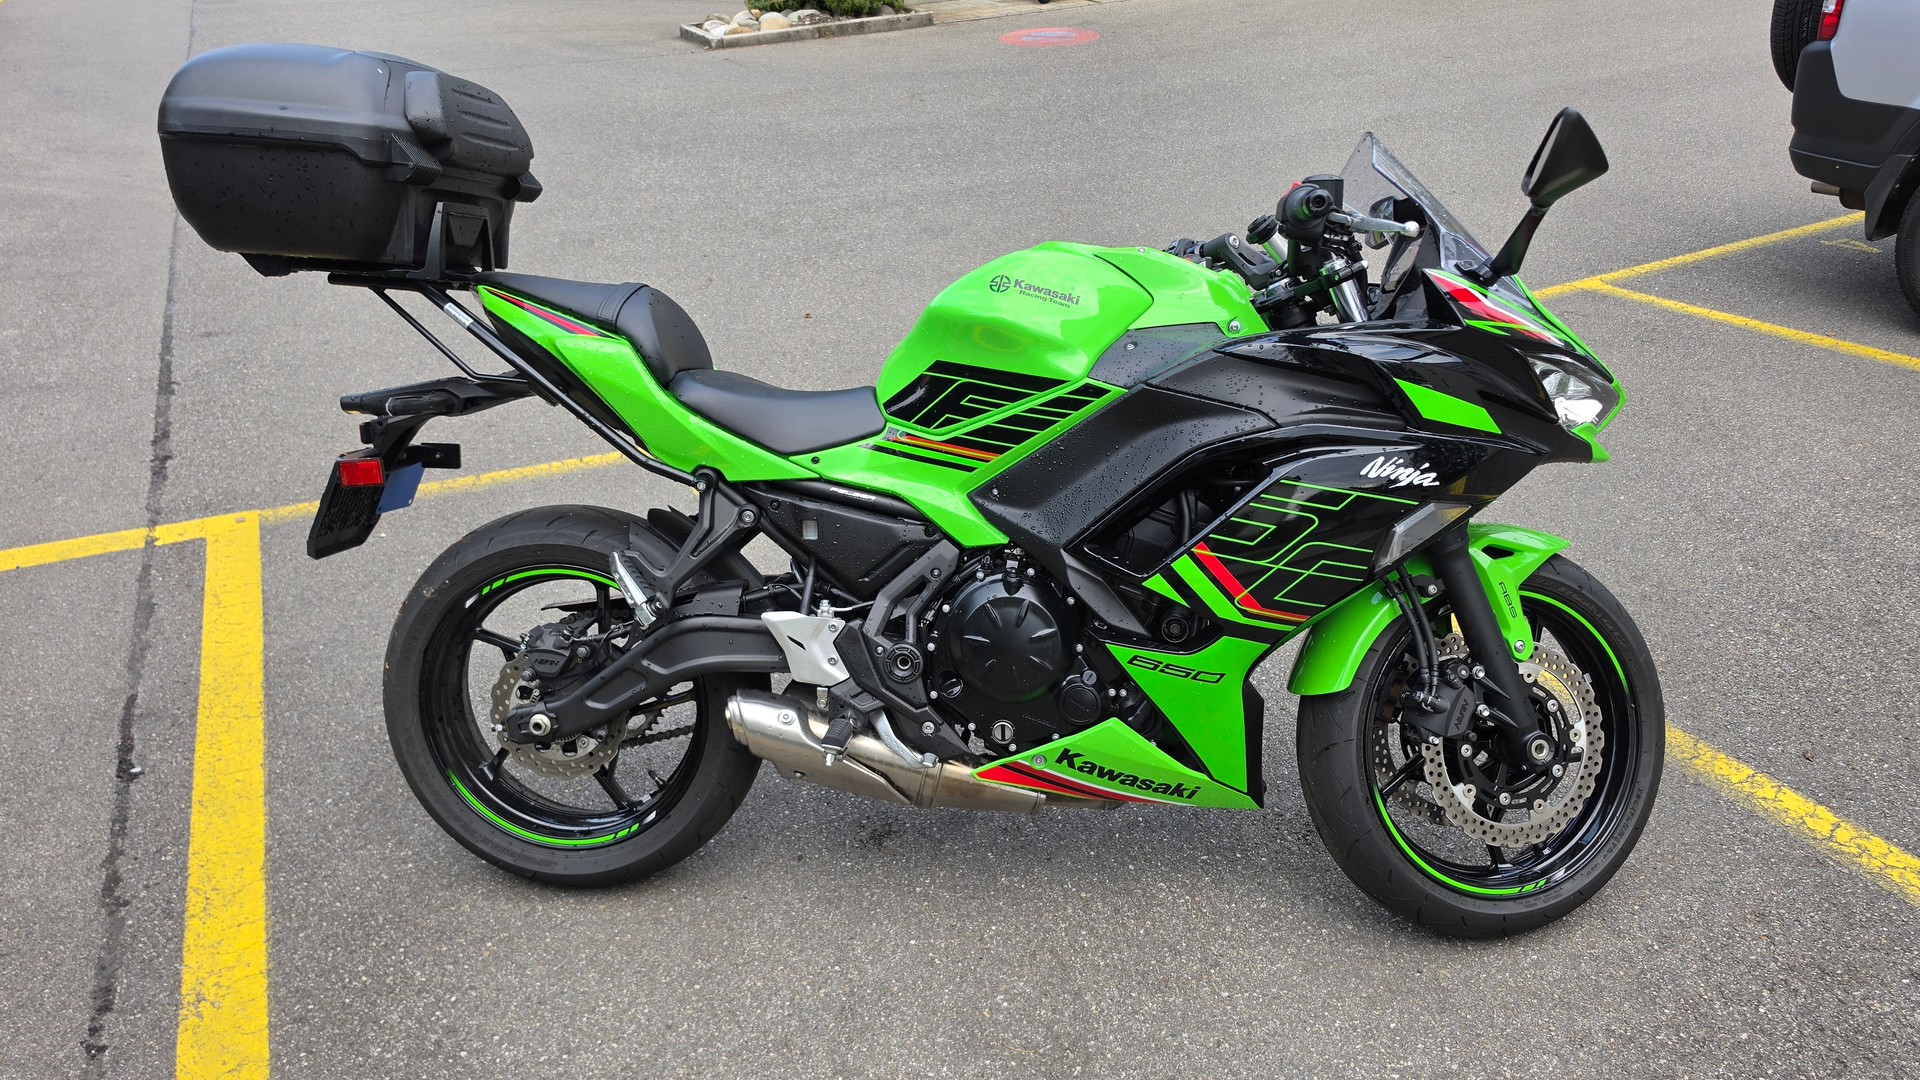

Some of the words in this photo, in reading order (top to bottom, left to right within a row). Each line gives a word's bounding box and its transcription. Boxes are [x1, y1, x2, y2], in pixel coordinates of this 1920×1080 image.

[1013, 279, 1080, 305] Kawasaki
[1019, 290, 1047, 302] Racing
[1049, 298, 1070, 308] Team
[1360, 456, 1440, 489] Ninja
[1498, 581, 1518, 619] ABS
[1126, 654, 1227, 685] 650
[1055, 747, 1202, 800] Kawasaki
